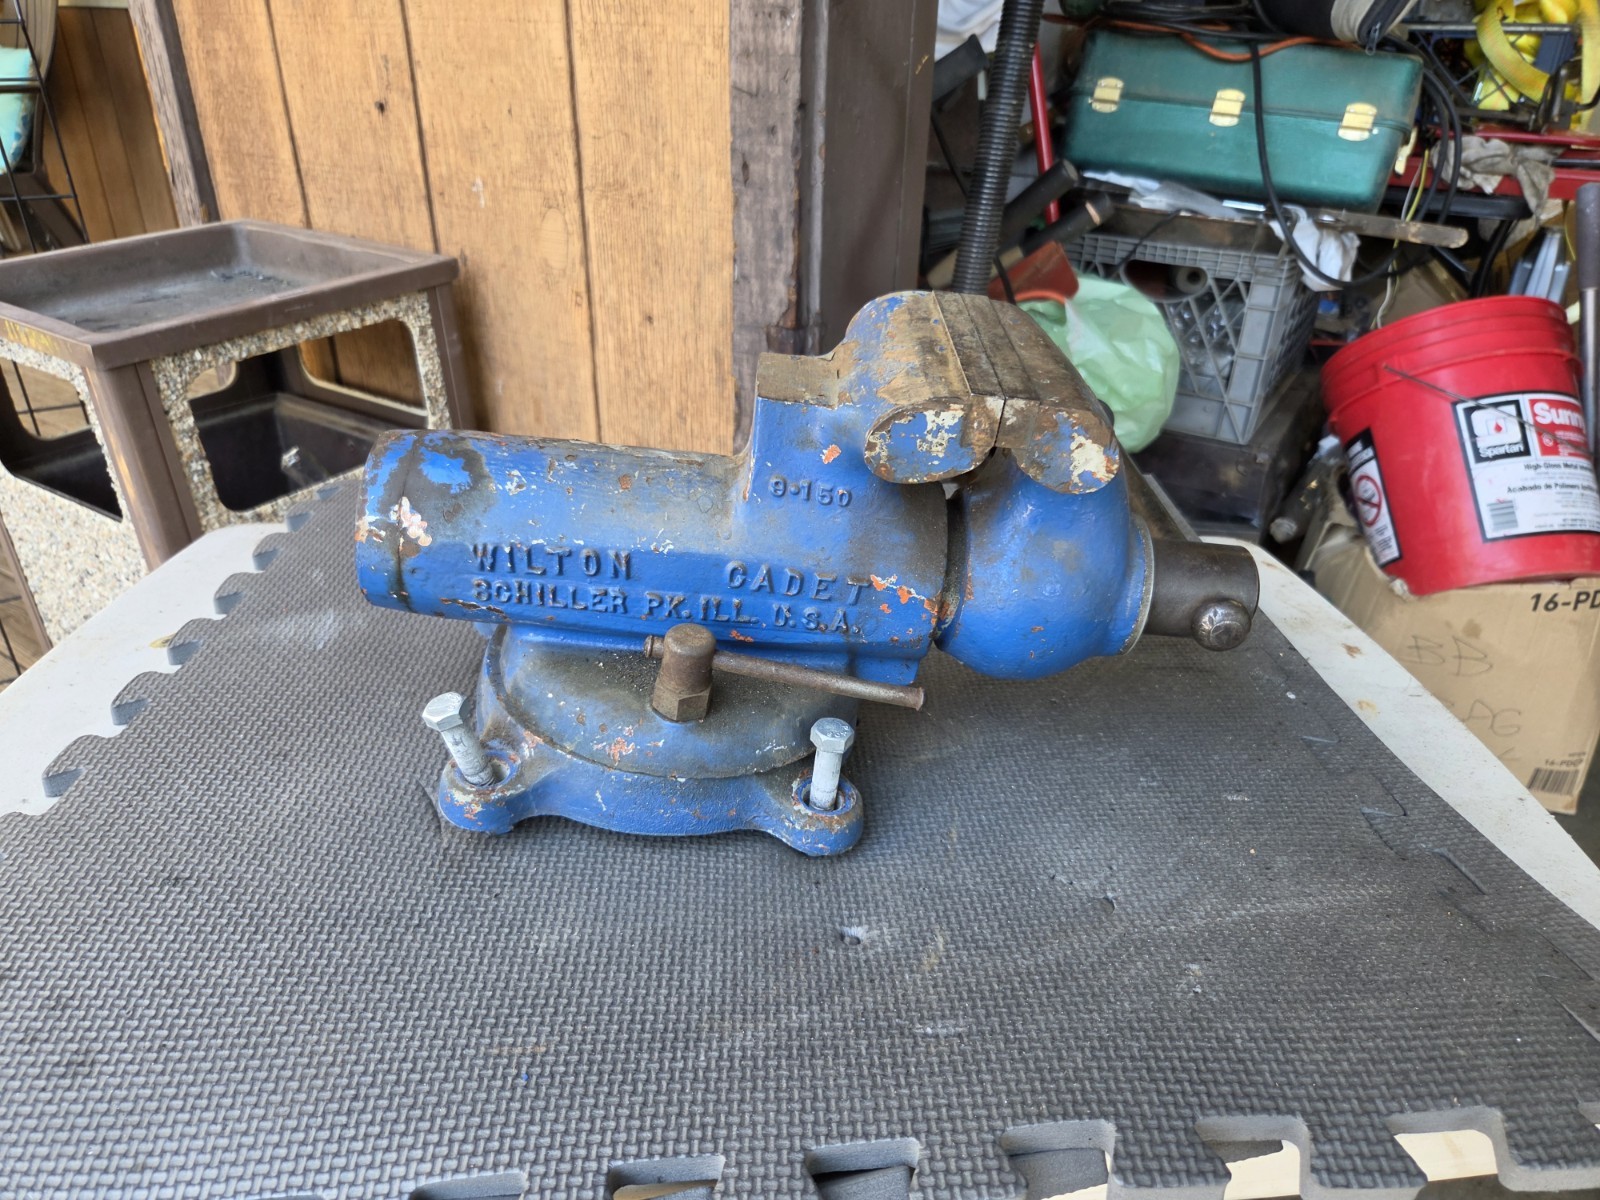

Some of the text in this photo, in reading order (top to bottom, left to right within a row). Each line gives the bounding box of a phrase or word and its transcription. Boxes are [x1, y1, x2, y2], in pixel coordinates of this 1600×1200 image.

[1533, 401, 1586, 434] Sunn
[1478, 441, 1524, 458] Spartan
[473, 543, 872, 606] WILTON CADET
[473, 578, 629, 615] SCHILLER
